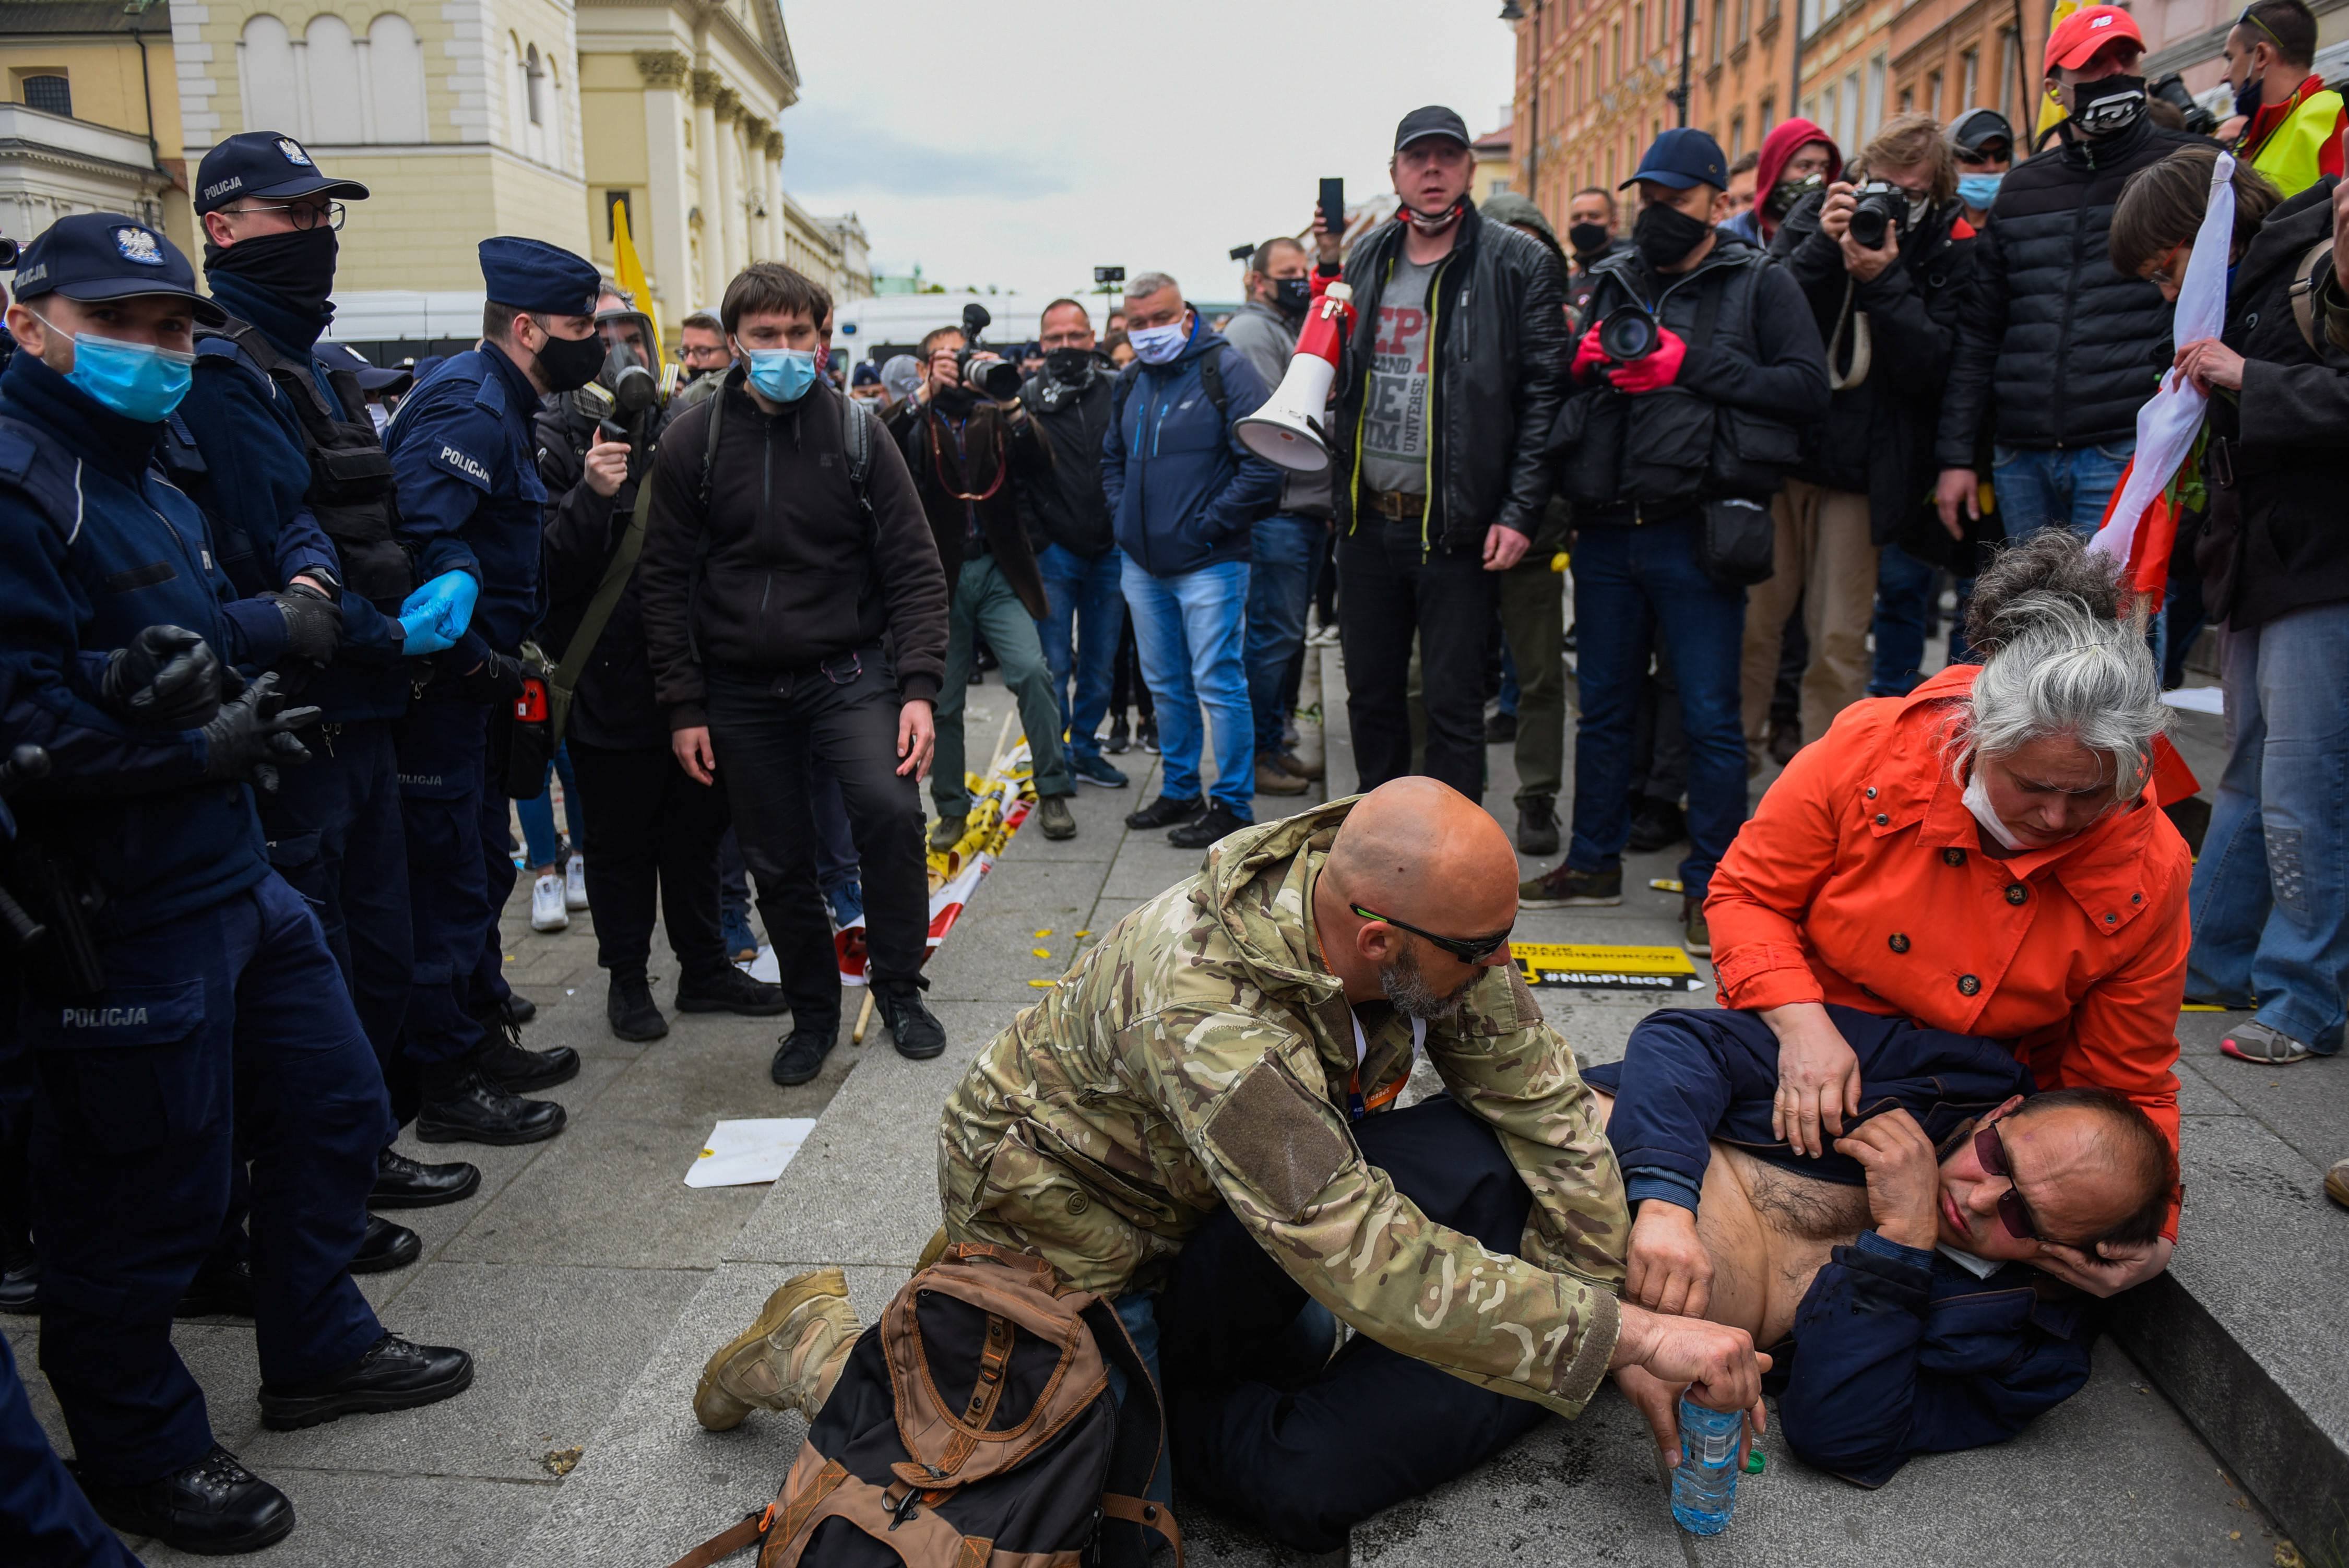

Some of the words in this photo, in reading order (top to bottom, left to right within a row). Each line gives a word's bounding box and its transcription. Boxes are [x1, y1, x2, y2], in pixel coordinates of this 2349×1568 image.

[203, 176, 243, 200] POLICJA
[440, 446, 490, 484] POLICJA
[63, 1007, 148, 1028] POLICJA
[1370, 1087, 1390, 1101] SPEED
